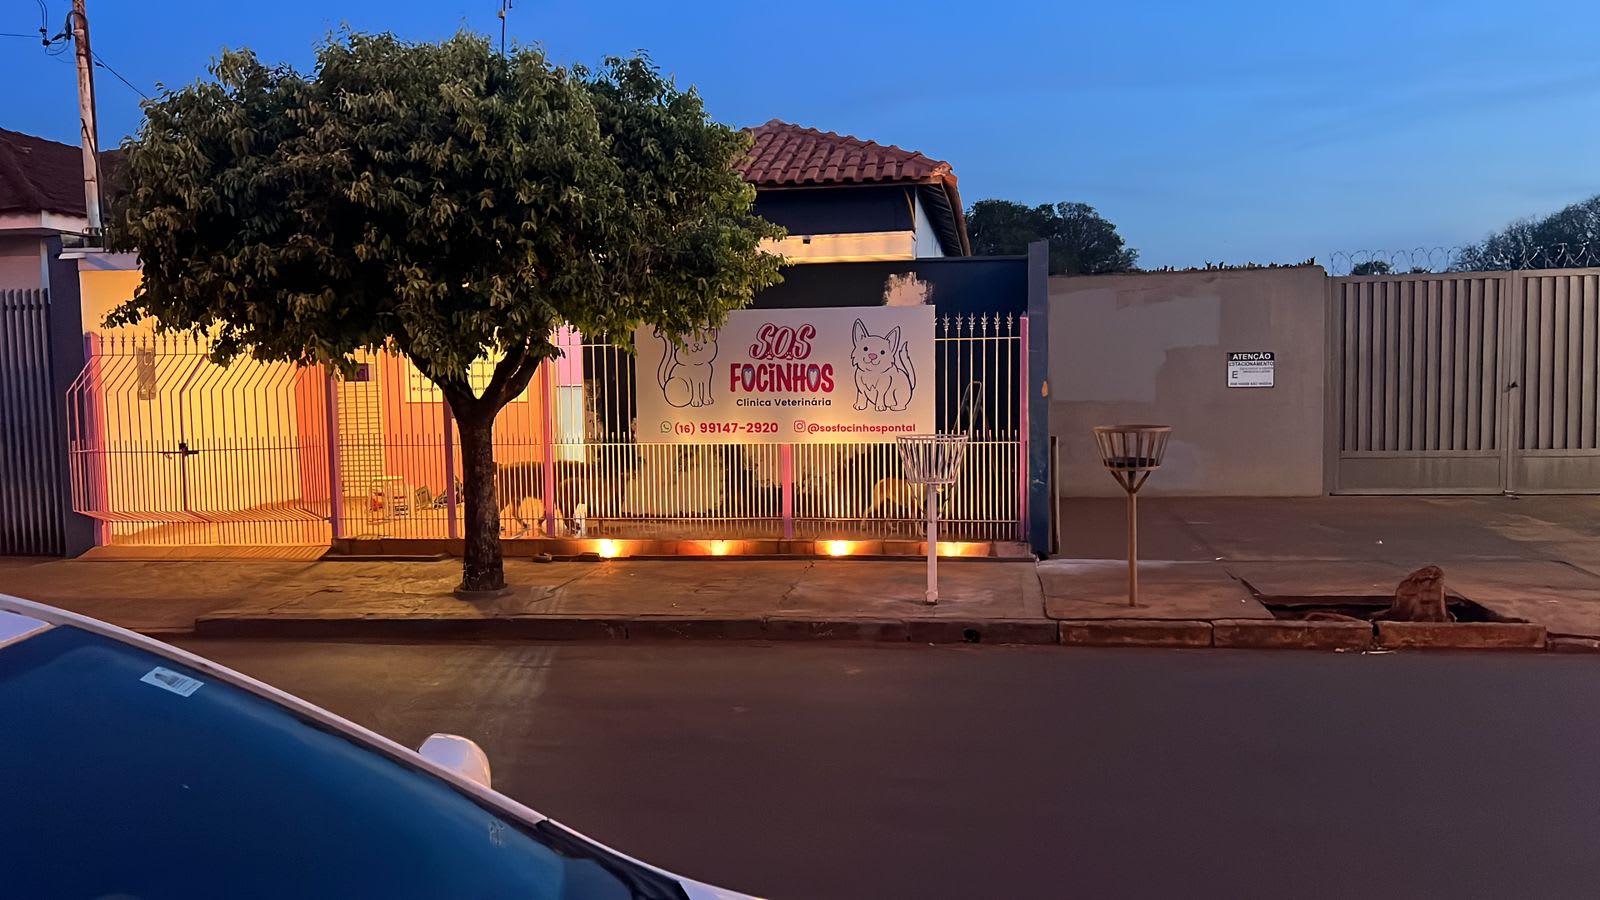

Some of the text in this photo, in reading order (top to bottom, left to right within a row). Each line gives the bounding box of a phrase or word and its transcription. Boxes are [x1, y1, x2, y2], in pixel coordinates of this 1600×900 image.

[1232, 352, 1271, 361] ATENÇÃO
[774, 397, 831, 406] Veterinária
[674, 422, 778, 435] (16) 99147-2920
[807, 423, 915, 434] @sosfocinhospontal
